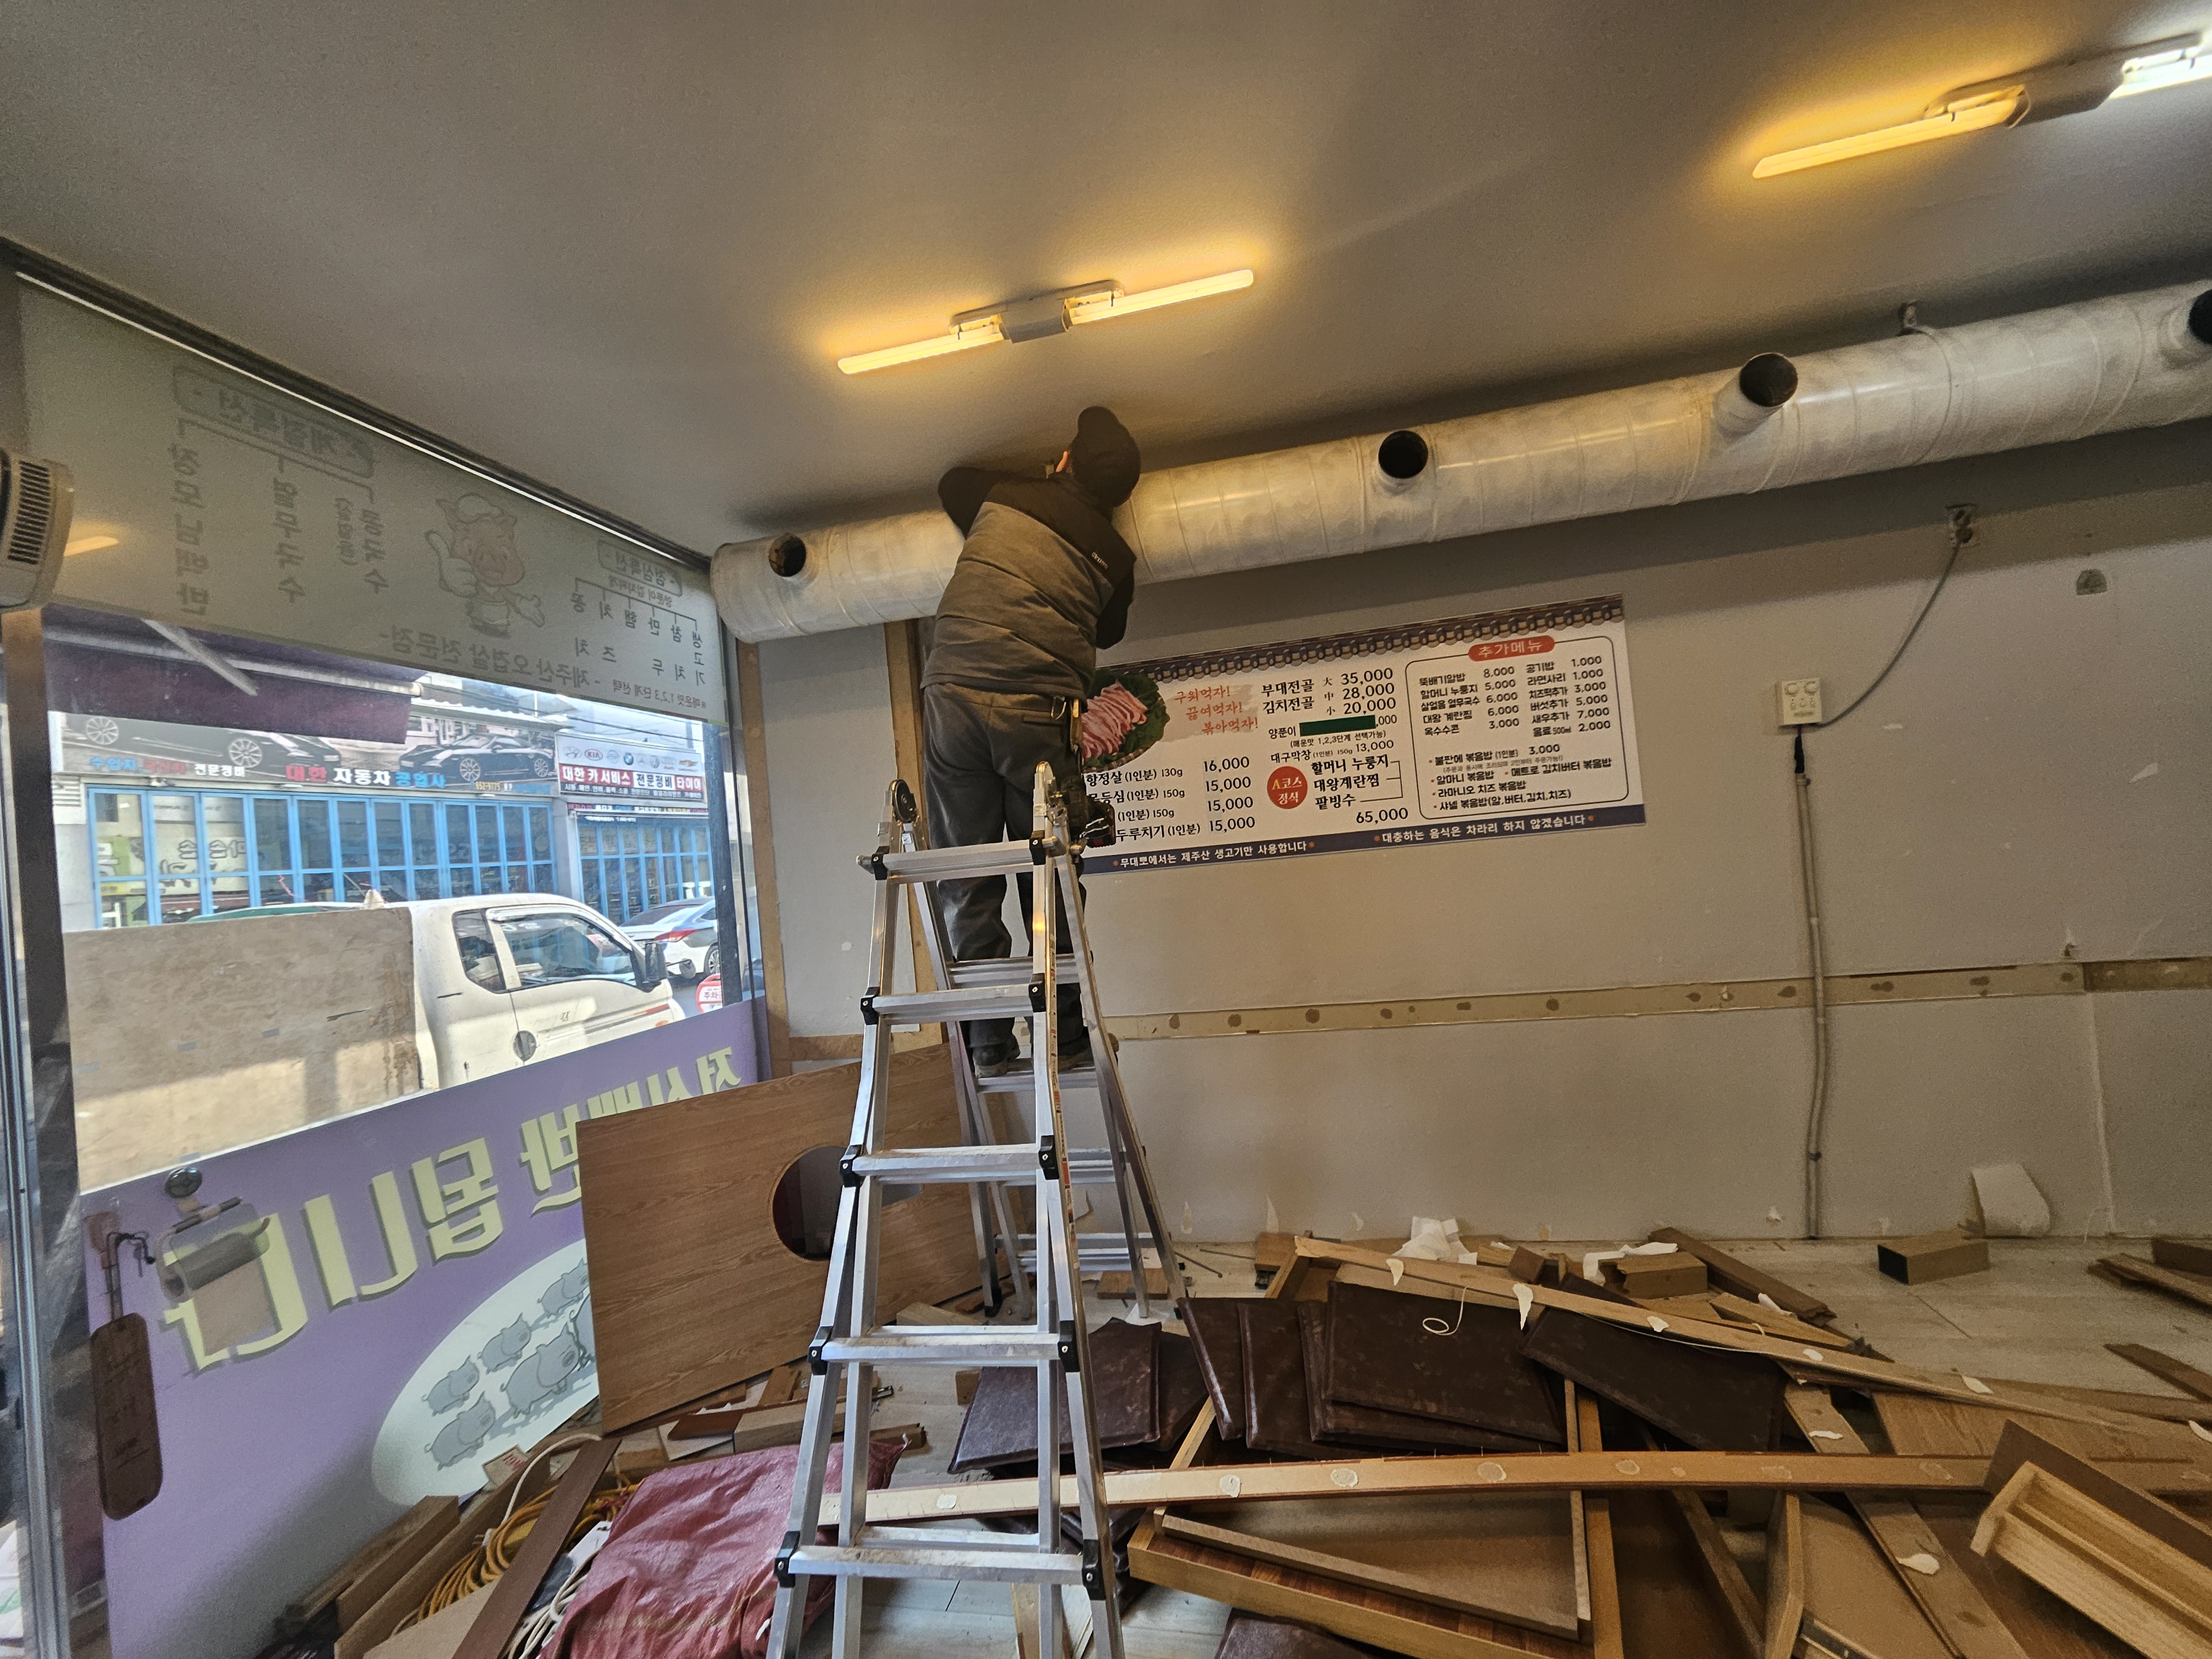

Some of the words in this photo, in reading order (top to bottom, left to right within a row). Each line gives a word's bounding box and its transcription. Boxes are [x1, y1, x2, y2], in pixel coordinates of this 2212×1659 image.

[1478, 640, 1543, 658] 추가메뉴
[1483, 666, 1515, 678] 8,000
[1526, 661, 1555, 674] 공기밥
[1571, 655, 1602, 667] 1,000
[1323, 677, 1332, 686] 大
[1340, 667, 1393, 686] 35,000
[1527, 673, 1566, 686] 라면사리
[1572, 669, 1604, 680] 1,000
[1261, 679, 1314, 697] 부대전골
[1324, 692, 1333, 701] 中
[1343, 682, 1395, 700] 28,000
[1420, 688, 1448, 700] 할머니
[1451, 684, 1478, 695] 누룽지
[1484, 679, 1516, 691] 5,000
[1574, 681, 1606, 693] 3,000
[1186, 701, 1242, 720] 끓여먹자!
[1262, 696, 1314, 714] 김치전골
[1326, 706, 1335, 716] 小
[1344, 697, 1396, 715] 20,000
[1421, 700, 1446, 712] 살얼음
[1448, 696, 1480, 709] 열무국수
[1486, 692, 1518, 703] 6,000
[1531, 698, 1569, 712] 버섯추가
[1576, 695, 1608, 706] 5,000
[1423, 713, 1441, 724] 대왕
[1488, 705, 1519, 717] 6,000
[1532, 711, 1570, 724] 새우추가
[1577, 707, 1609, 719] 7,000
[1202, 717, 1258, 735] 볶아먹자!
[1269, 726, 1296, 739] 양푼이
[1425, 724, 1460, 737] 옥수수콘
[1489, 718, 1520, 729] 3,000
[1533, 727, 1552, 738] 음료
[1578, 720, 1611, 732] 2,000
[1290, 738, 1314, 748] (매운맛
[1318, 734, 1351, 745] 1,2,3단계
[1354, 731, 1386, 741] 선택가능)
[1271, 749, 1311, 764] 대구막창
[1313, 750, 1333, 758] (1인분)
[1355, 739, 1394, 753] 13,000
[1465, 750, 1493, 763] 볶음밥
[1495, 749, 1519, 760] (1인분)
[1528, 744, 1560, 755] 3,000
[194, 763, 246, 778] 전문정비
[1086, 771, 1122, 787] 항정살
[1124, 769, 1157, 783] (1인분)
[1161, 768, 1183, 778] 130g
[1203, 756, 1250, 773] 16,000
[1311, 759, 1347, 775] 할머니
[1352, 754, 1389, 771] 누룽지
[1543, 761, 1580, 774] 김치버터
[1583, 758, 1611, 770] 볶음밥
[285, 764, 327, 783] 대한
[333, 767, 391, 786] 자동차
[394, 771, 446, 788] 공업사
[562, 766, 585, 782] 대한
[587, 768, 598, 783] 카
[601, 770, 630, 785] 서비스
[637, 773, 672, 789] 전문정비
[676, 776, 701, 791] 타이어
[1272, 776, 1302, 790] A코스
[1314, 773, 1380, 792] 대왕계란찜
[1436, 774, 1464, 785] 알마니
[1467, 770, 1494, 782] 볶음밥
[1126, 788, 1159, 802] (1인분)
[1164, 789, 1185, 799] 150g
[1205, 776, 1251, 793] 15,000
[1438, 786, 1475, 797] 라마니오
[1478, 784, 1496, 794] 치즈
[1498, 780, 1527, 792] 볶음밥
[1278, 791, 1299, 805] 정식
[1314, 794, 1357, 810] 팥빙수
[1439, 800, 1458, 811] 샤넬
[1118, 808, 1150, 822] (1인분)
[1153, 809, 1175, 818] 150g
[1207, 796, 1254, 813] 15,000
[1356, 807, 1408, 825] 65,000
[1167, 823, 1201, 837] (1인분)
[1209, 816, 1255, 833] 15,000
[1382, 831, 1425, 843] 대충하는
[1430, 827, 1461, 839] 음식은
[1467, 823, 1498, 836] 차라리
[1503, 820, 1525, 832] 하지
[1530, 814, 1585, 830] 않겠습니다
[1120, 854, 1177, 868] 무대뽀에서는
[1181, 851, 1210, 862] 제주산
[1214, 846, 1253, 859] 생고기만
[1258, 841, 1307, 855] 사용합니다
